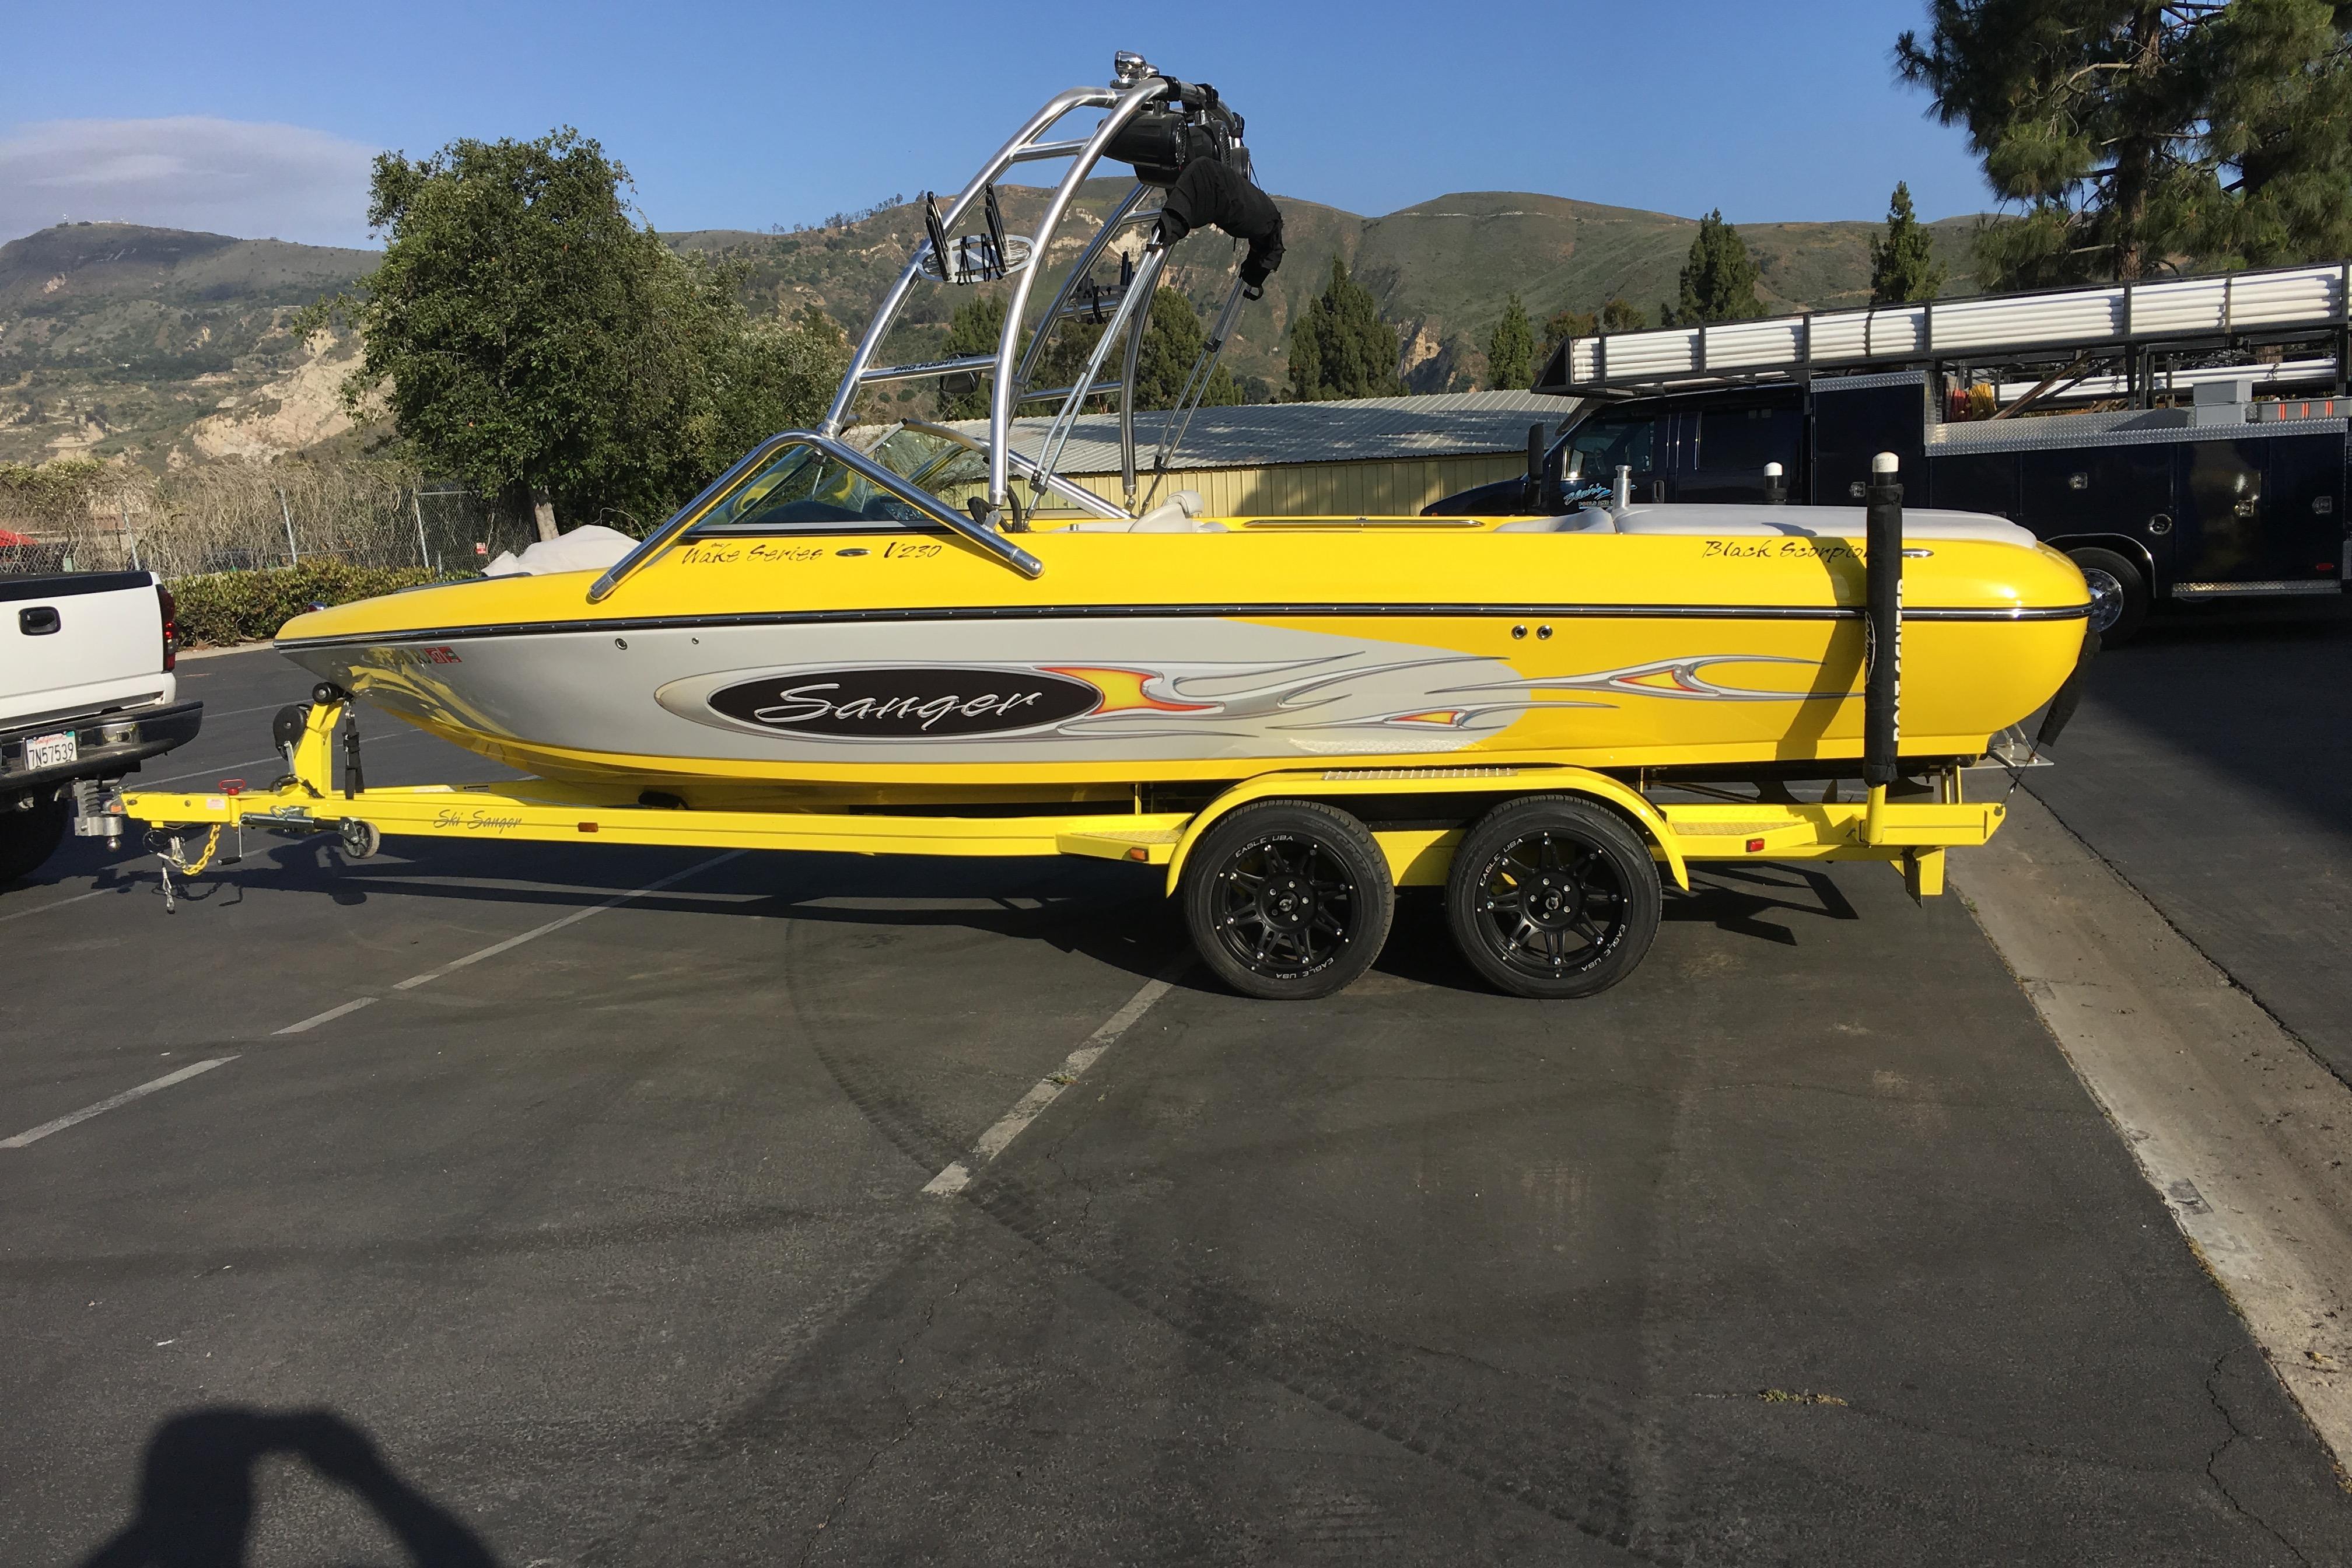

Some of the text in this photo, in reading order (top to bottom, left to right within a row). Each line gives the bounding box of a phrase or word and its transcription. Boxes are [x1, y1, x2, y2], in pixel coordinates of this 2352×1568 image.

[682, 543, 823, 564] Wake Series
[884, 542, 942, 558] V230
[1702, 540, 1772, 558] Black
[754, 683, 1042, 731] Sanger
[29, 742, 74, 766] 7N57539
[433, 809, 522, 834] Ski Sanger
[1235, 837, 1267, 858] EAGLE
[1479, 838, 1524, 887] EAGLE USA
[1581, 924, 1626, 972] EAGLE USA
[1303, 957, 1334, 977] EAGLE
